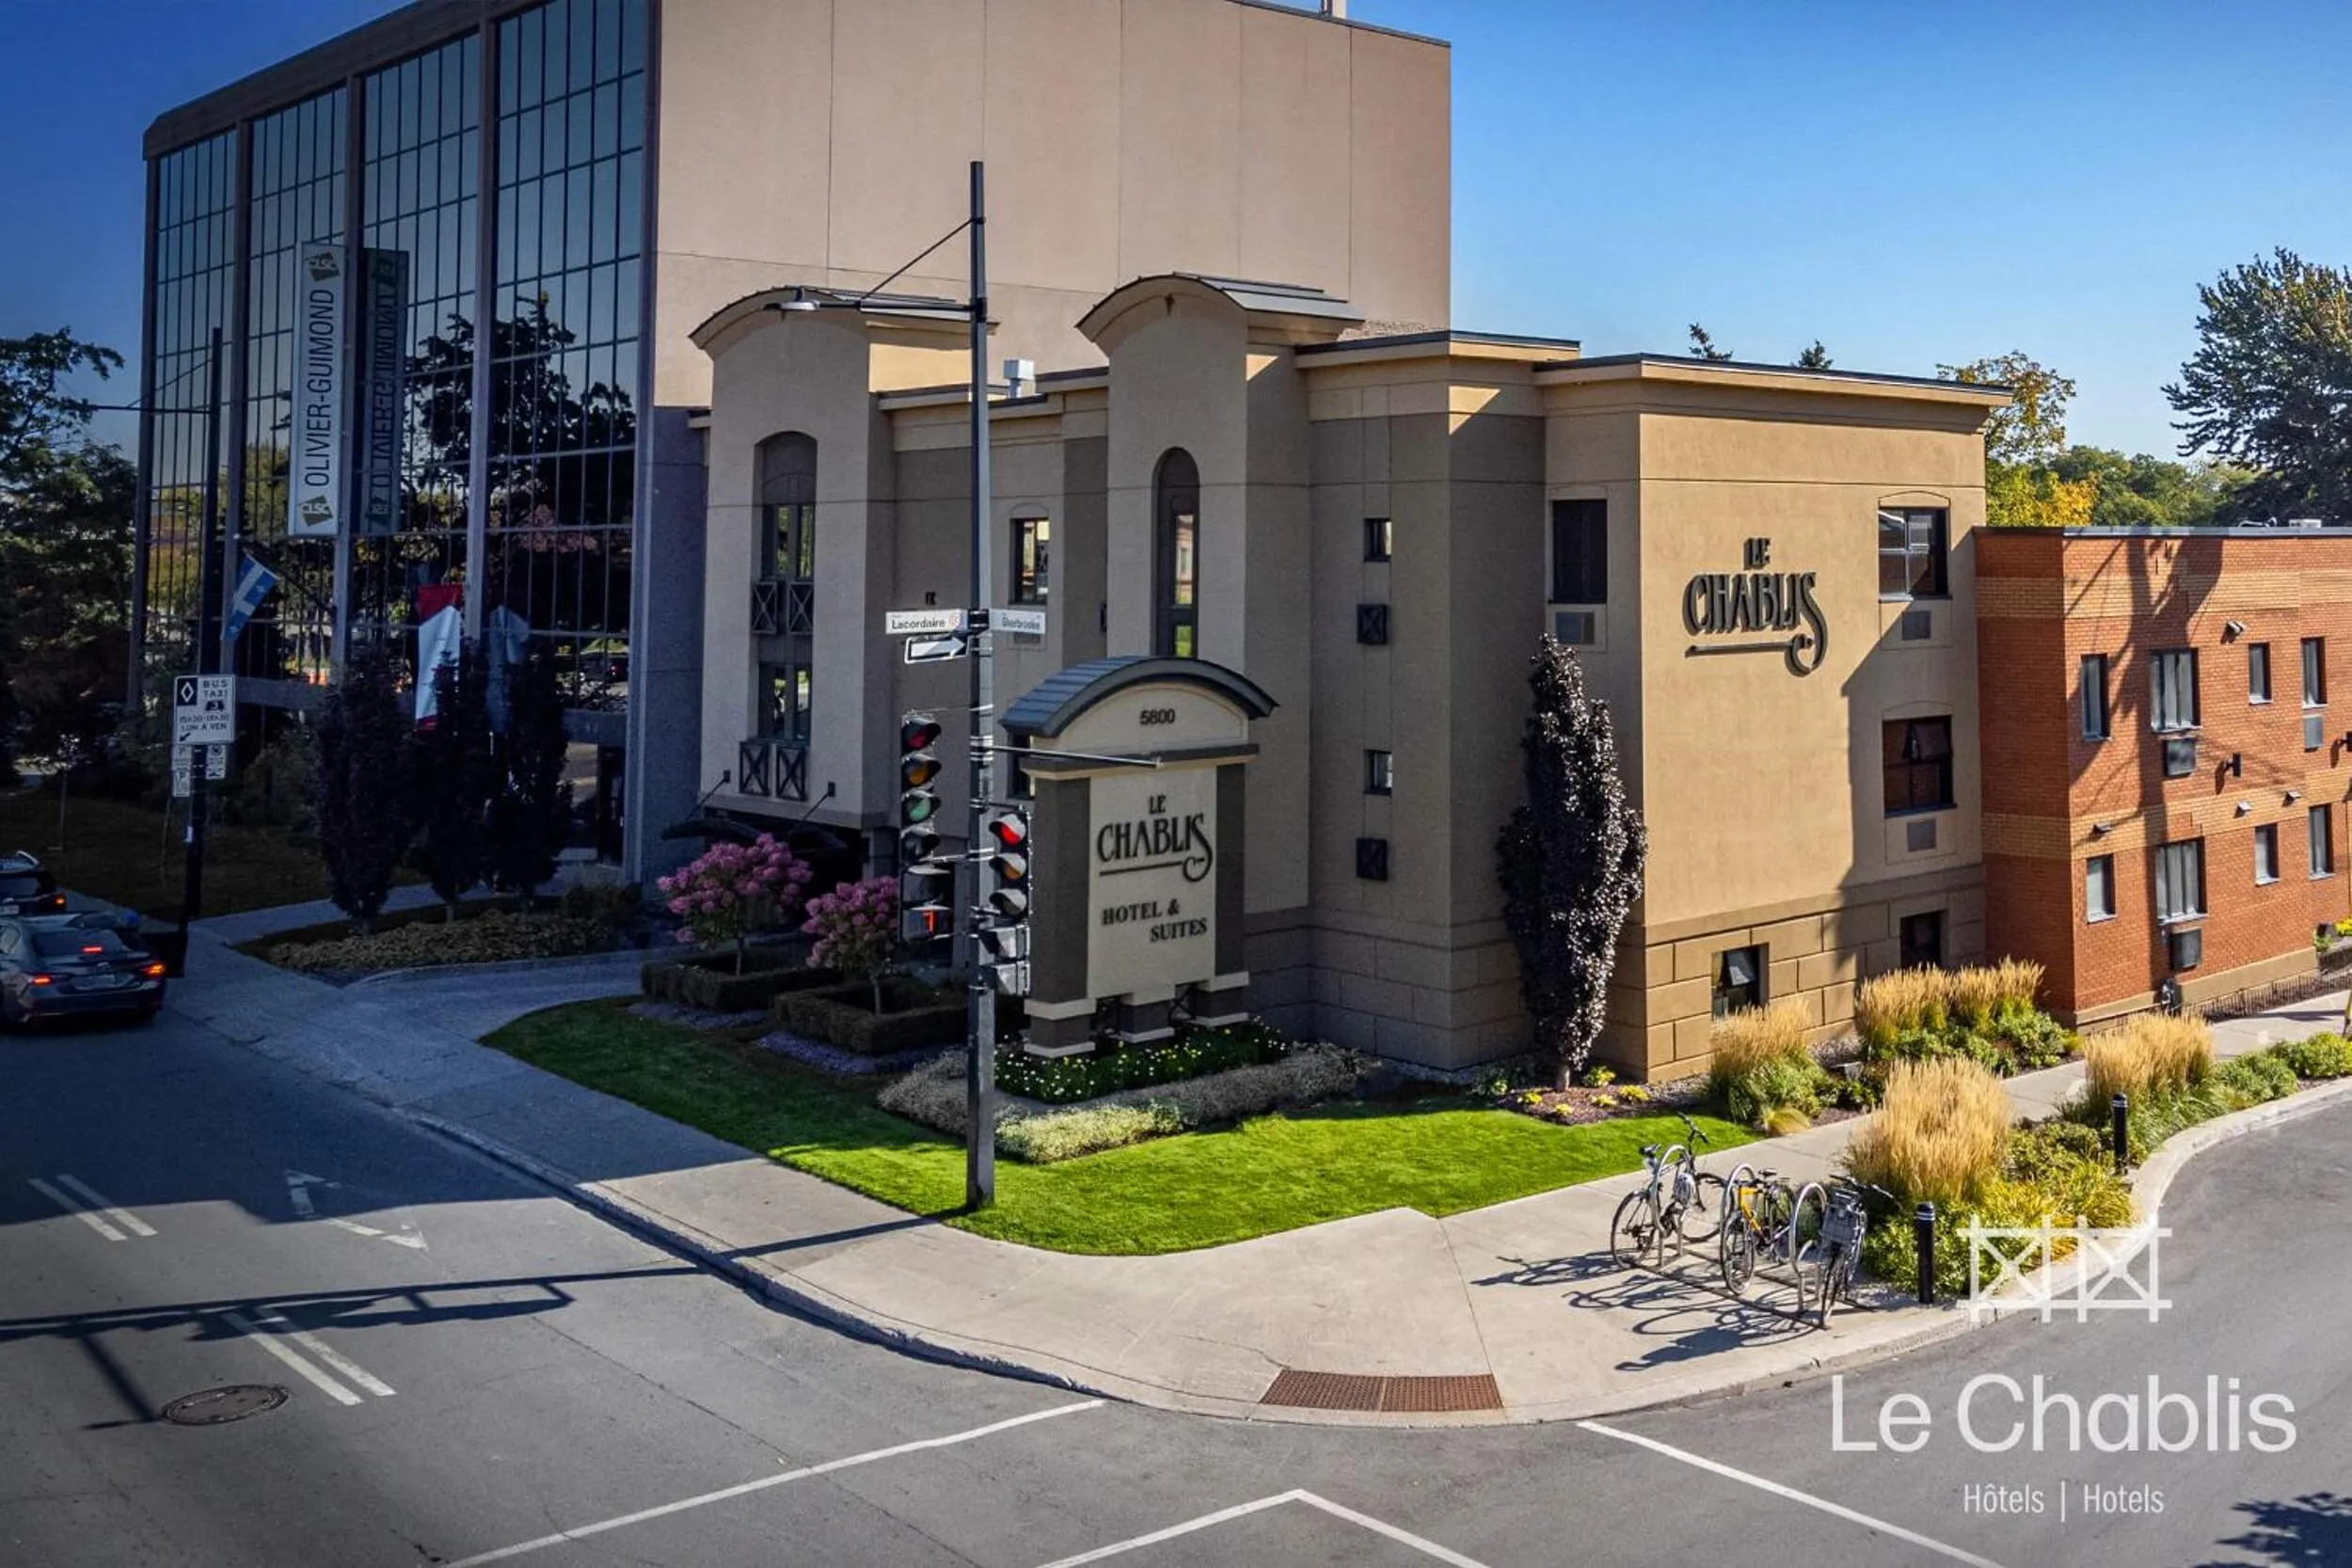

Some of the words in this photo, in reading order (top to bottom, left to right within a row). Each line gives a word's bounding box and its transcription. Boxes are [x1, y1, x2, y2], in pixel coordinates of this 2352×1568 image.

[305, 289, 335, 487] OLIVIER-GUIMOND
[1743, 538, 1771, 570] LE
[891, 617, 946, 630] Lacordaire
[1682, 572, 1828, 677] CHABLIS
[203, 680, 228, 689] BUS
[1140, 708, 1175, 725] 5800
[1149, 795, 1167, 814] LE
[1097, 813, 1213, 882] CHABLIS
[1102, 900, 1163, 926] HOTEL
[1167, 898, 1181, 916] &
[1150, 918, 1208, 942] SUITES
